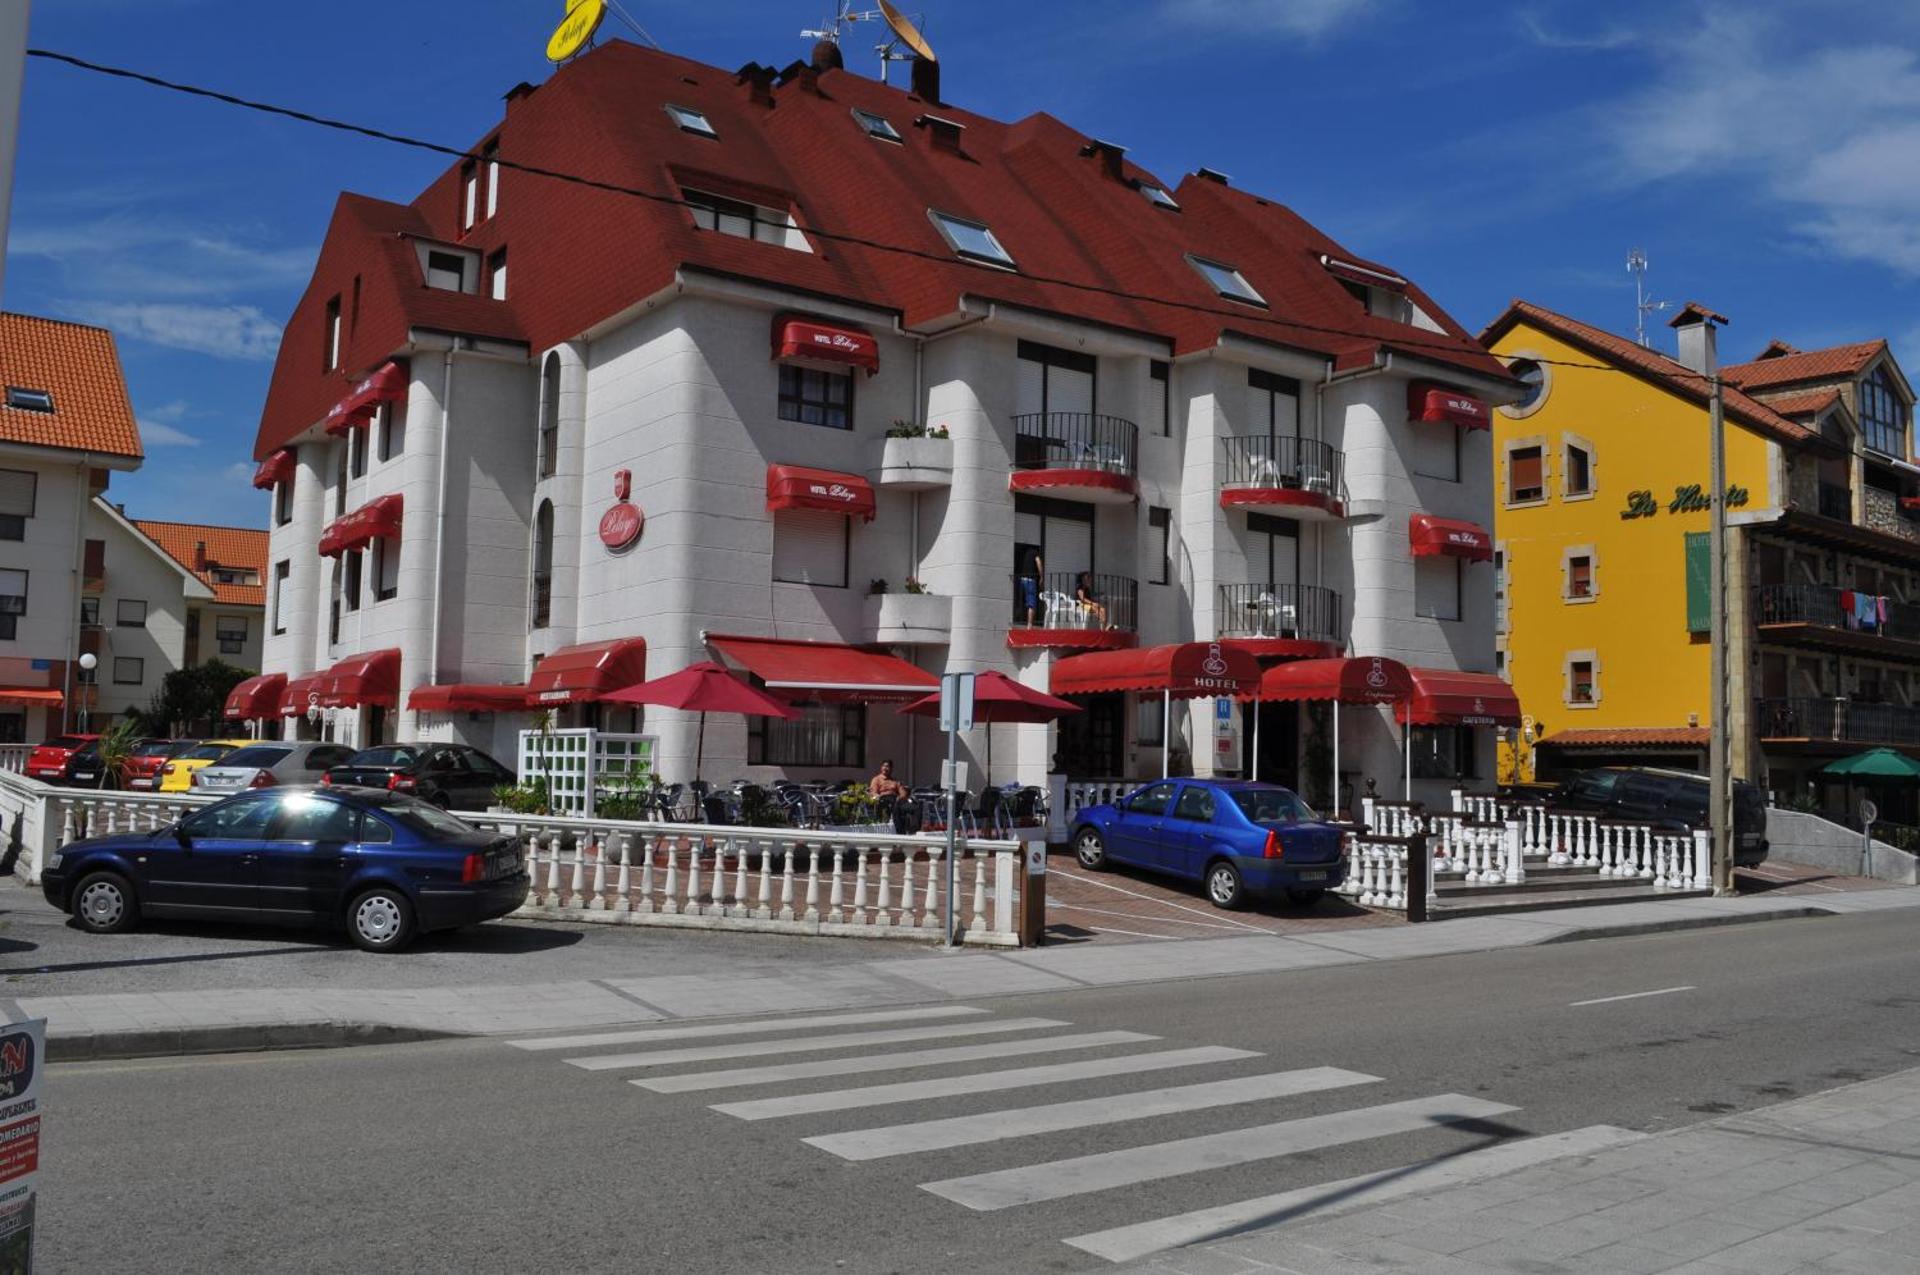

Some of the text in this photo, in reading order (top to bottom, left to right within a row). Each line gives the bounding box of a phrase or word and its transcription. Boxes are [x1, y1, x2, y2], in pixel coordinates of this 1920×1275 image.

[1620, 484, 1749, 520] La Hueta
[1195, 677, 1239, 690] HOTEL
